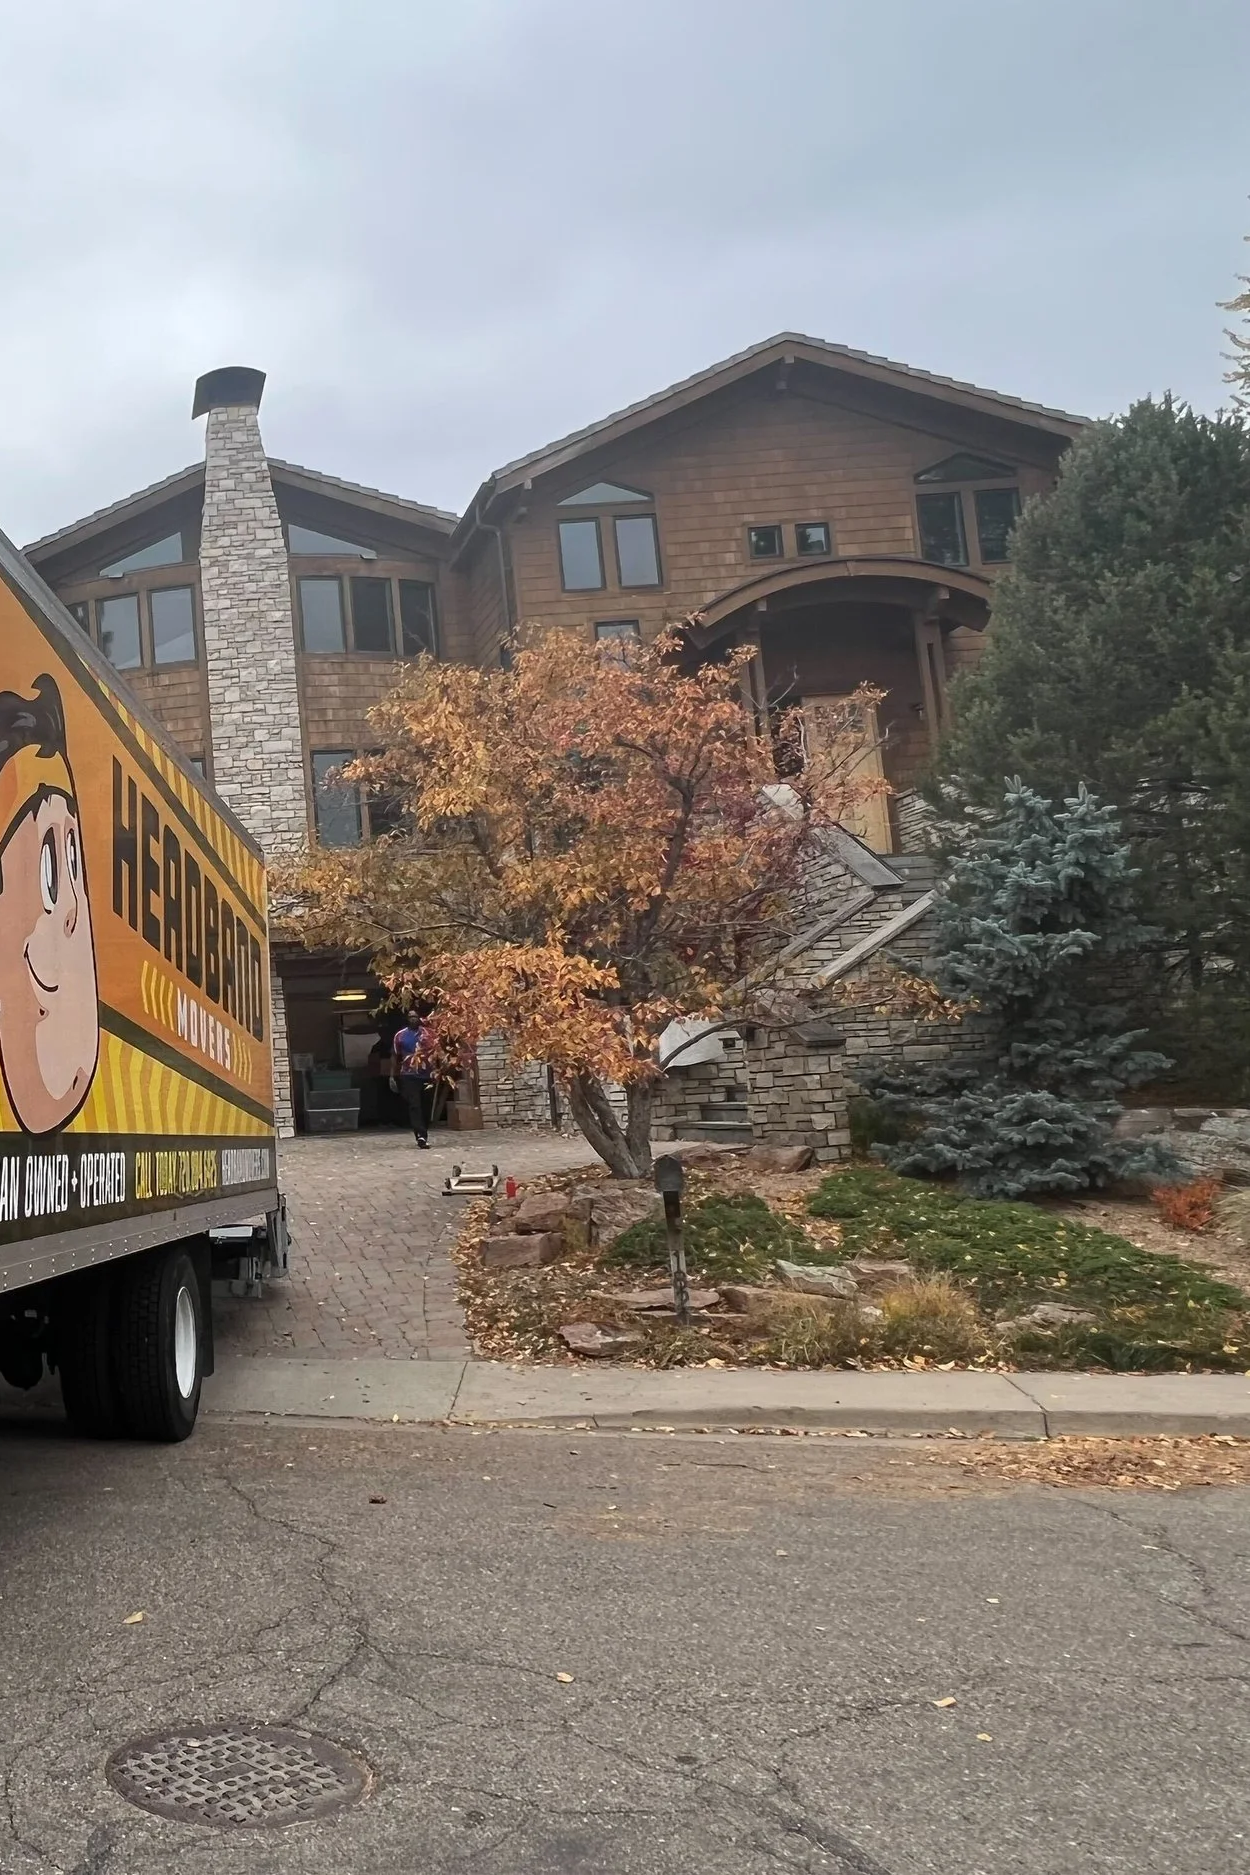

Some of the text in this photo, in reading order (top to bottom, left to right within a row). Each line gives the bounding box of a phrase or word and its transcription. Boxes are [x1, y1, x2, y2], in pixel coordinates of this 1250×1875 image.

[112, 755, 263, 1043] HEADBAND
[177, 987, 232, 1071] MOVERS
[25, 1154, 68, 1218] OWNED
[80, 1152, 126, 1209] OPERATED
